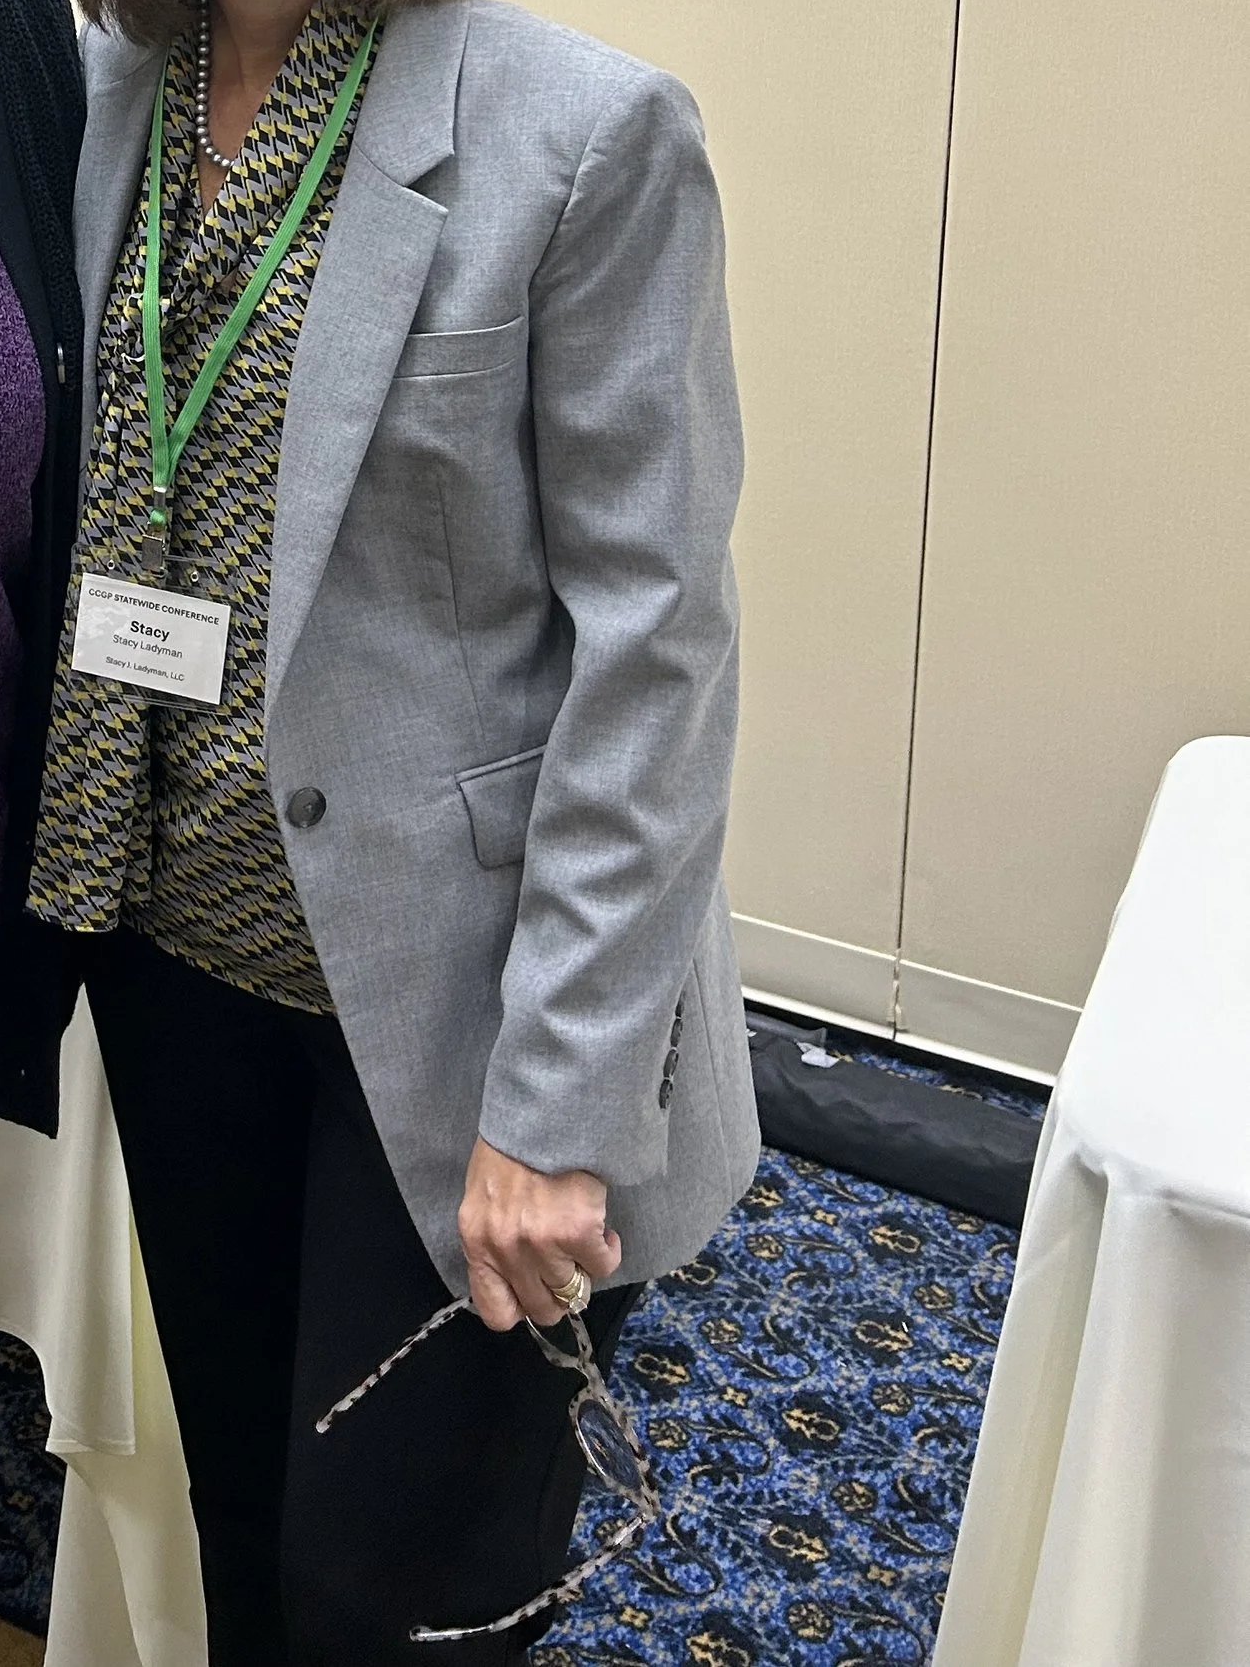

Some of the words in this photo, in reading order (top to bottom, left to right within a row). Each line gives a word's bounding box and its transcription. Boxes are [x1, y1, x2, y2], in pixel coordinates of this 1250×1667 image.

[89, 588, 113, 599] CCGP
[114, 594, 160, 611] STATEWIDE
[162, 605, 219, 625] CONFERENCE
[130, 620, 170, 642] Stacy
[113, 634, 138, 649] Stacy
[140, 641, 182, 658] Ladyman
[106, 656, 126, 668] Stacy
[170, 672, 185, 681] LLC
